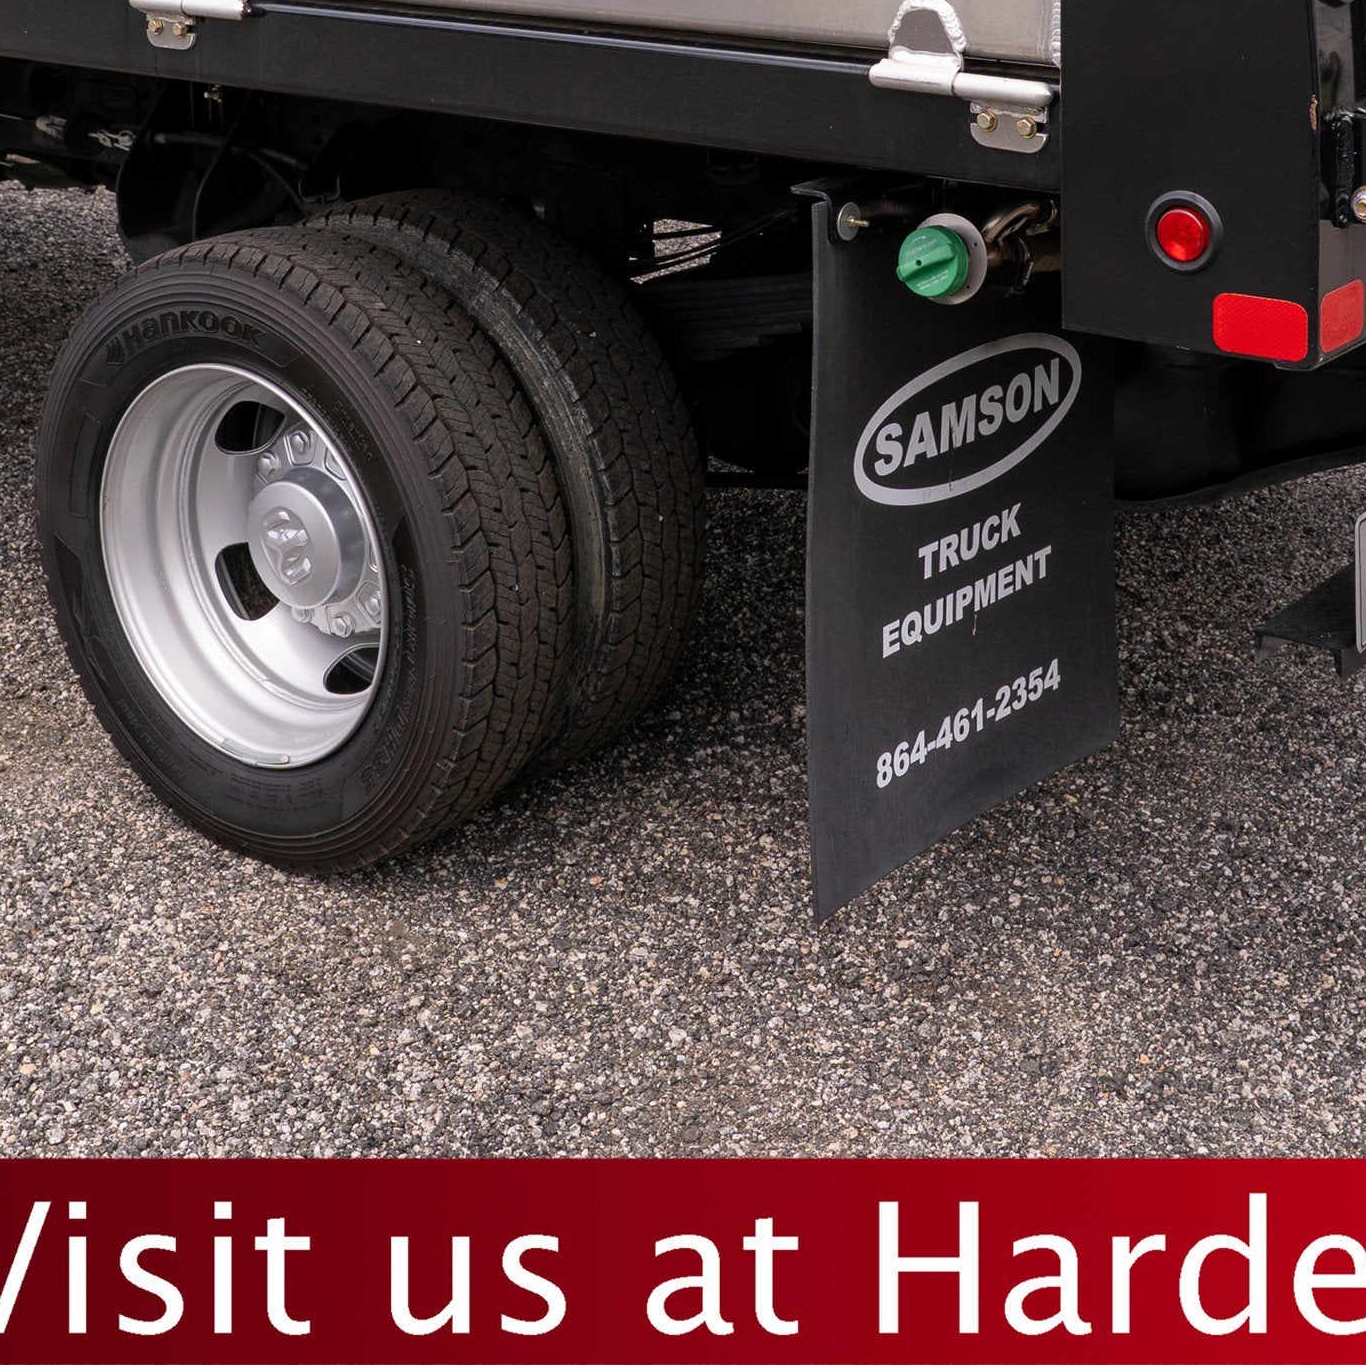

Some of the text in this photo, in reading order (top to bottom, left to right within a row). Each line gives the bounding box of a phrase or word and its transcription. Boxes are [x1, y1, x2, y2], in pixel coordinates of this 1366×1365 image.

[873, 356, 1060, 477] SAMSON
[918, 502, 1022, 580] TRUCK
[882, 543, 1053, 659] EQUIPMENT
[875, 657, 1062, 789] 864-461-2354
